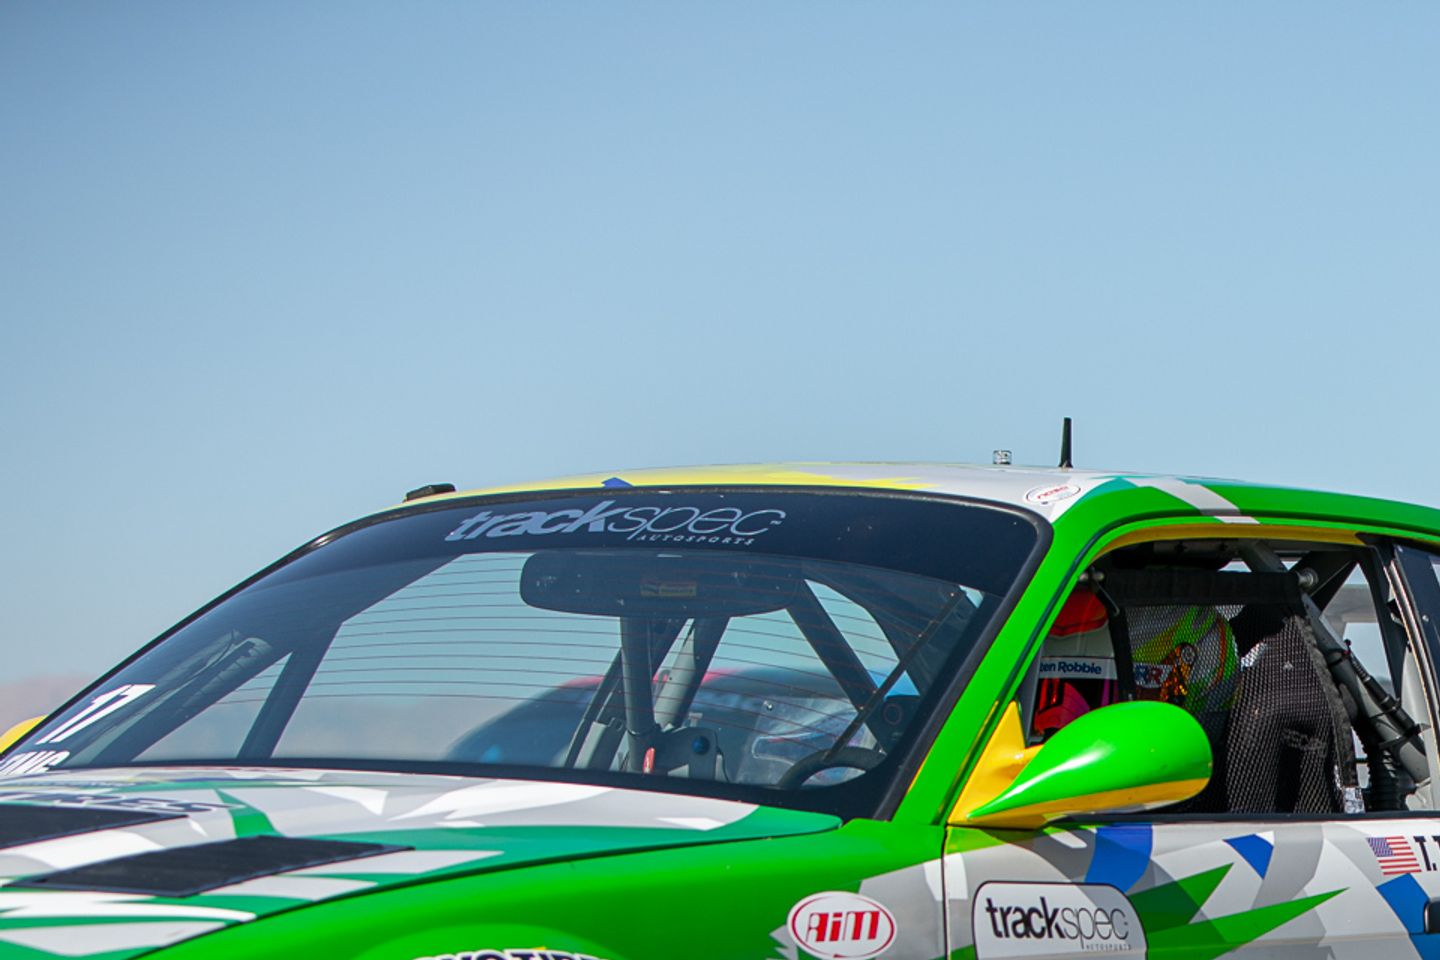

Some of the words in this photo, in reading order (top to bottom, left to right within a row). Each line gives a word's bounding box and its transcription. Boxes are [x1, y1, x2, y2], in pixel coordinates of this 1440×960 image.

[445, 500, 787, 541] trackspec
[636, 534, 754, 545] AUTOSPORTS
[1058, 661, 1102, 675] Robbie
[35, 684, 157, 745] 17
[1413, 835, 1438, 872] T.
[985, 896, 1129, 950] trackspec
